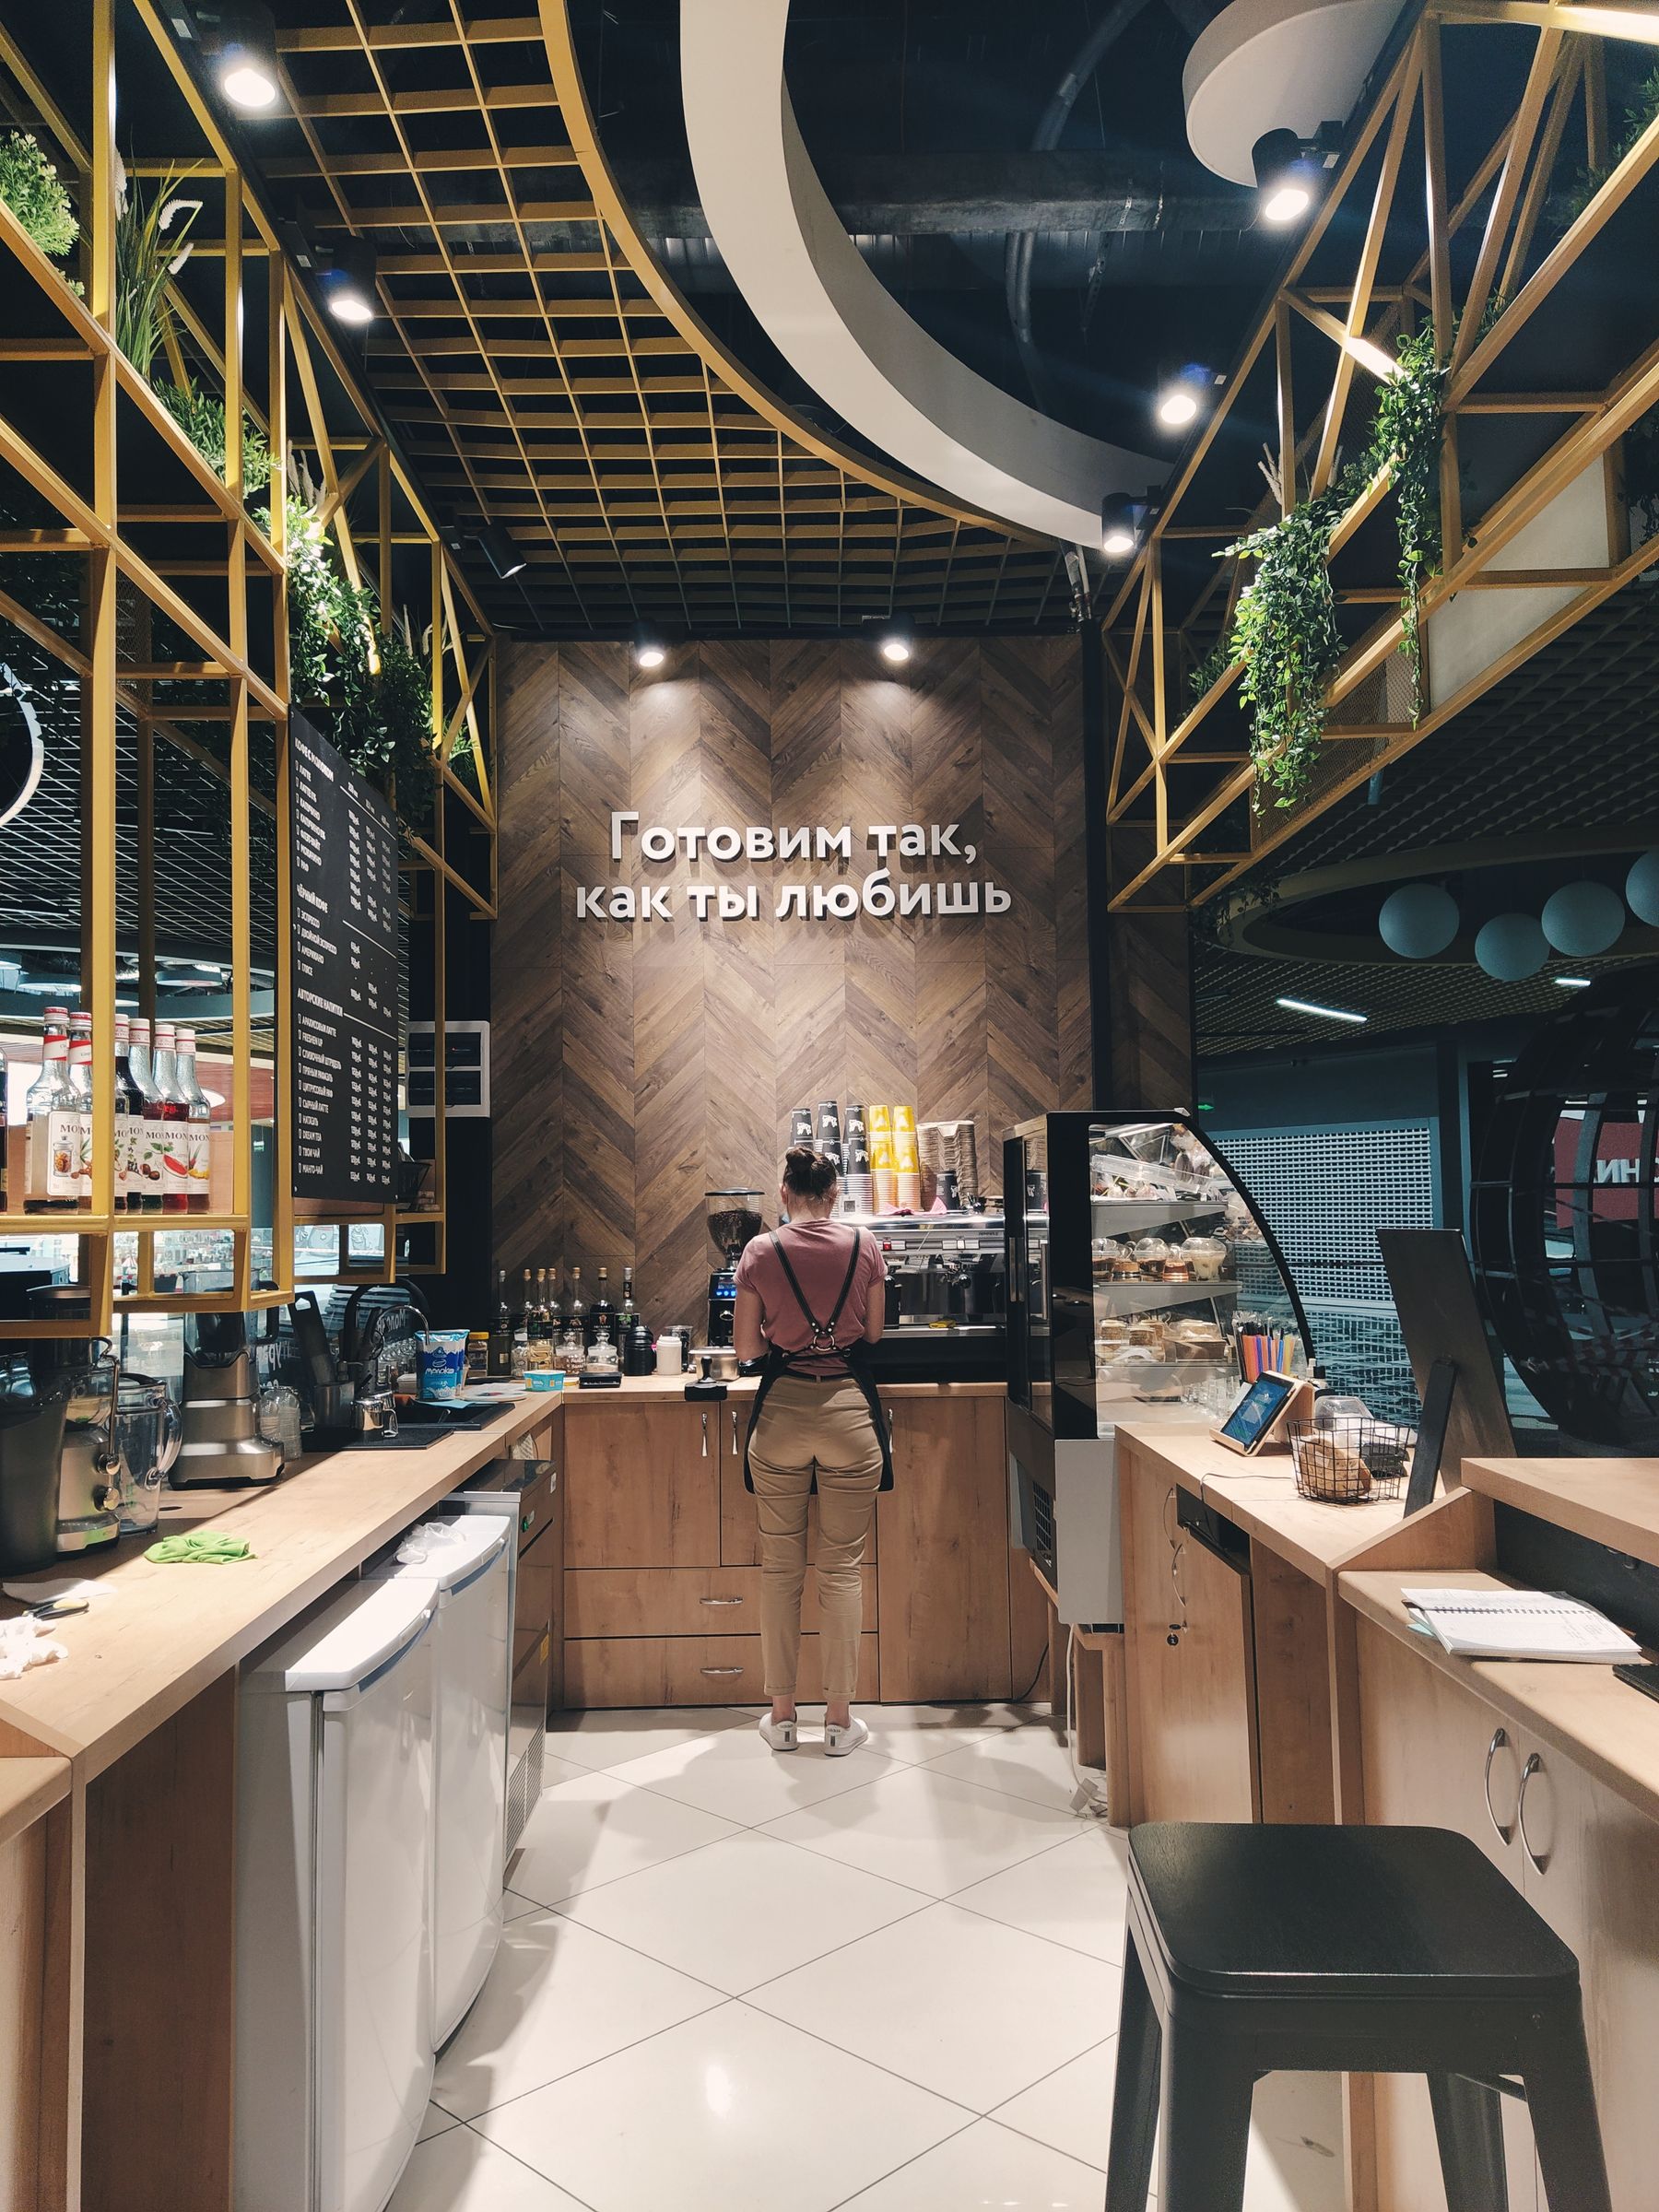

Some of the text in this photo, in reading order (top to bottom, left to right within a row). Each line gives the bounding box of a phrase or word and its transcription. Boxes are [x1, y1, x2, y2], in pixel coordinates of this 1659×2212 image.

[609, 810, 978, 865] Готовим так,
[576, 867, 1012, 921] как ты любишь
